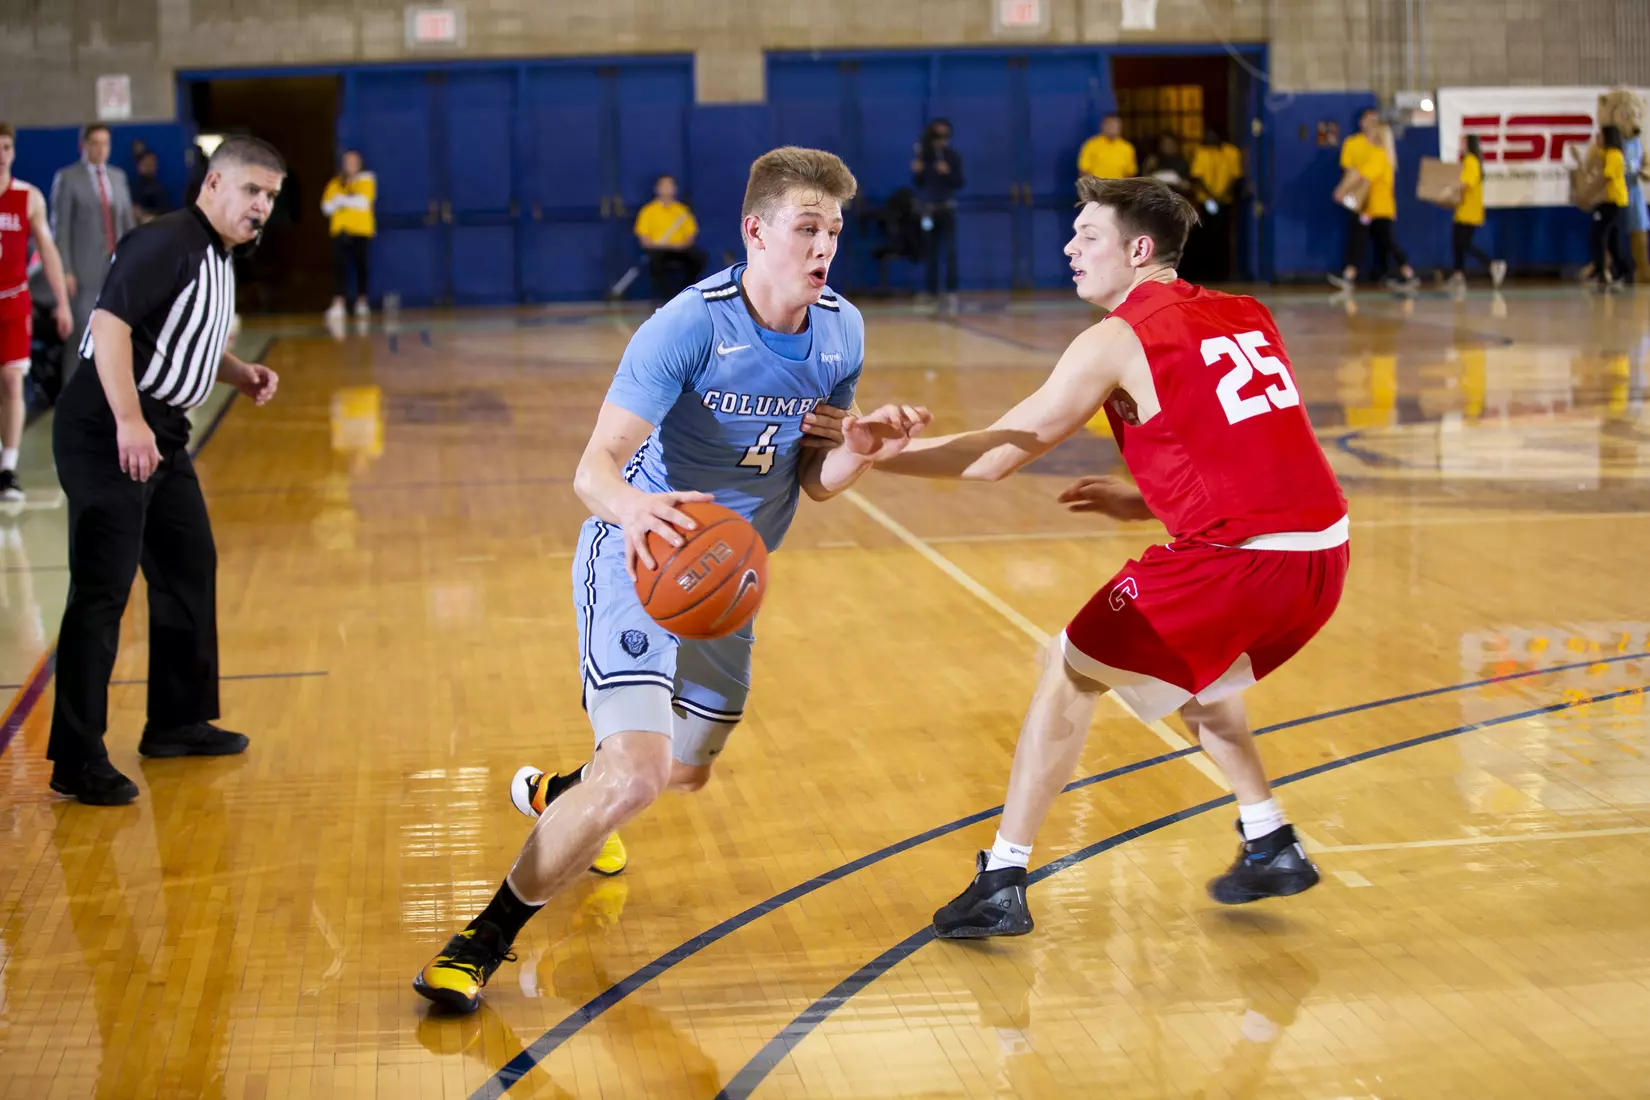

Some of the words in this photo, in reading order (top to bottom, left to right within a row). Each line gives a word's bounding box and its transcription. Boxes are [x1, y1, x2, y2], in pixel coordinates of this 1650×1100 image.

[1461, 114, 1594, 162] ESP
[1200, 330, 1300, 425] 25
[735, 423, 782, 476] 4
[675, 540, 733, 592] ELITE
